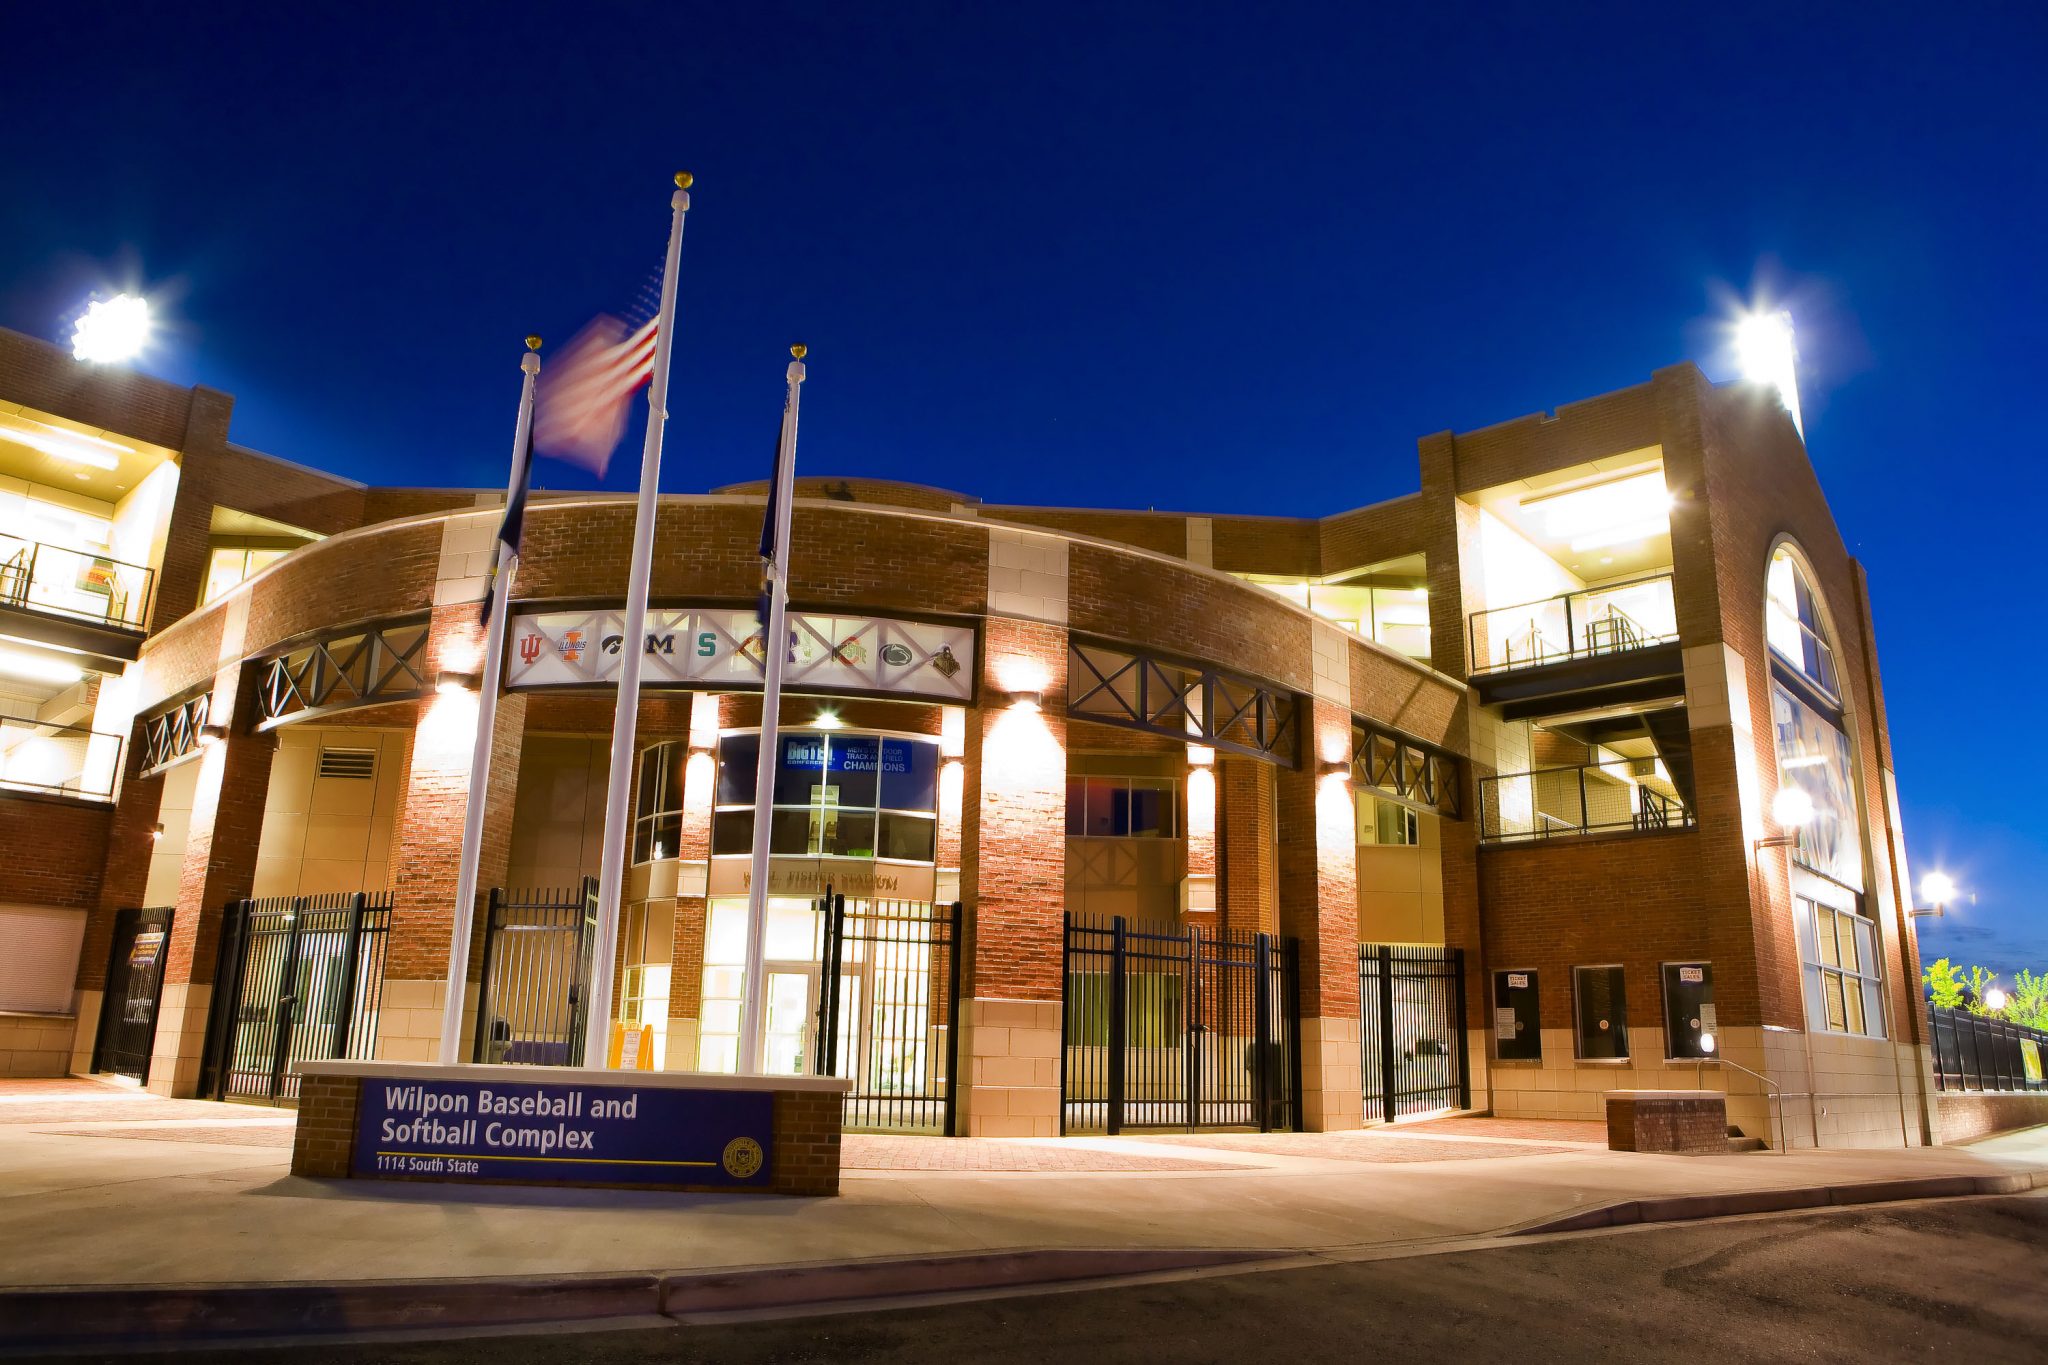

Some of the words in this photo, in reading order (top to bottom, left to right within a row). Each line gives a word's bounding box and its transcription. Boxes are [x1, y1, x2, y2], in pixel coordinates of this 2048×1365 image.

[558, 640, 587, 652] ILLINOIS
[645, 634, 676, 655] M
[697, 632, 717, 657] S
[846, 752, 869, 760] TRACK
[843, 760, 905, 772] CHAMPIONS
[385, 1086, 469, 1118] Wilpon
[478, 1090, 583, 1117] Baseball
[590, 1094, 638, 1119] and
[381, 1117, 477, 1145] Softball
[485, 1122, 595, 1154] Complex
[377, 1155, 406, 1170] 1114
[409, 1157, 444, 1172] South
[447, 1158, 479, 1173] State
